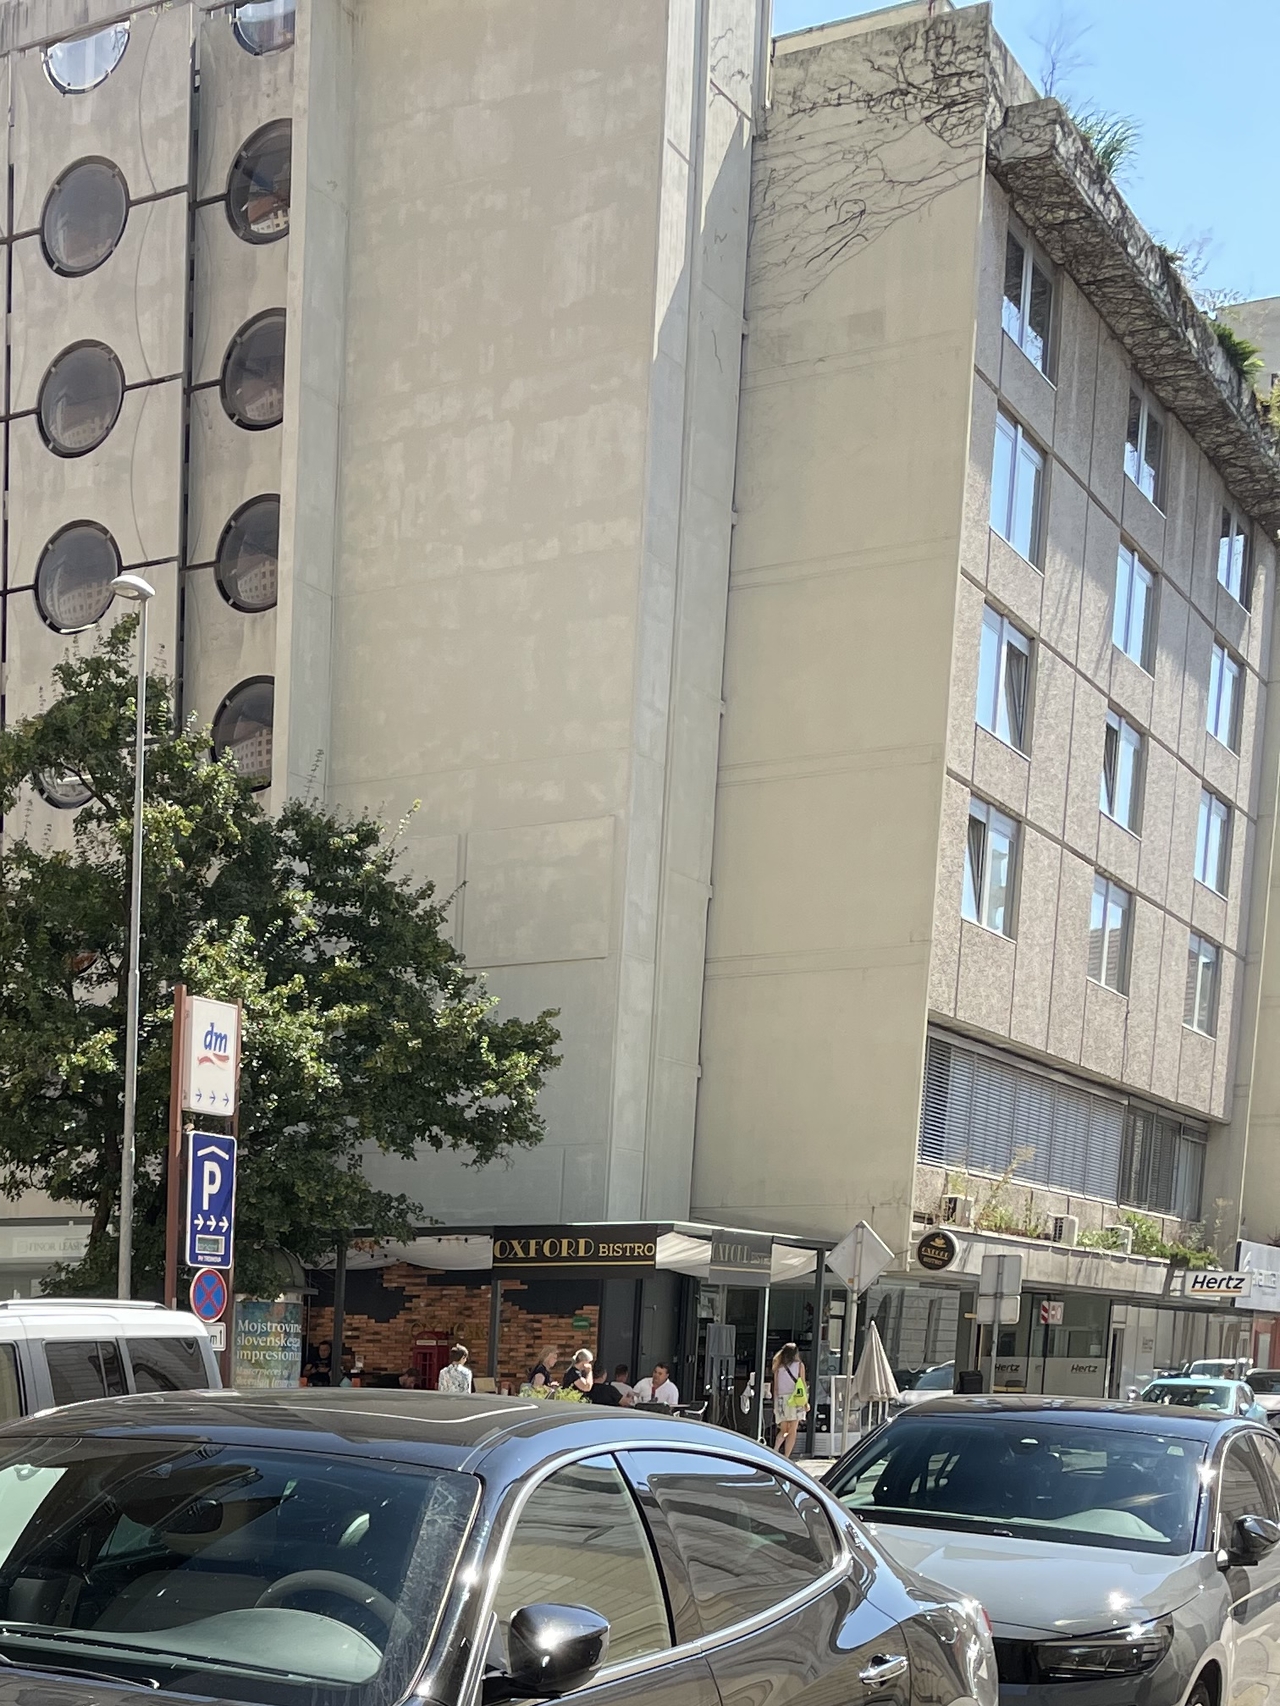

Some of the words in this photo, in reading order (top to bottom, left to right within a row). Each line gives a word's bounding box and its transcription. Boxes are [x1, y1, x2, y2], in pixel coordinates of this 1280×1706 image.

[203, 1022, 228, 1053] dm
[202, 1161, 222, 1210] P
[493, 1237, 595, 1259] OXFORD
[598, 1243, 655, 1257] BISTRO
[1192, 1274, 1245, 1289] Hertz
[995, 1363, 1020, 1372] Hertz
[1071, 1364, 1098, 1373] Hertz
